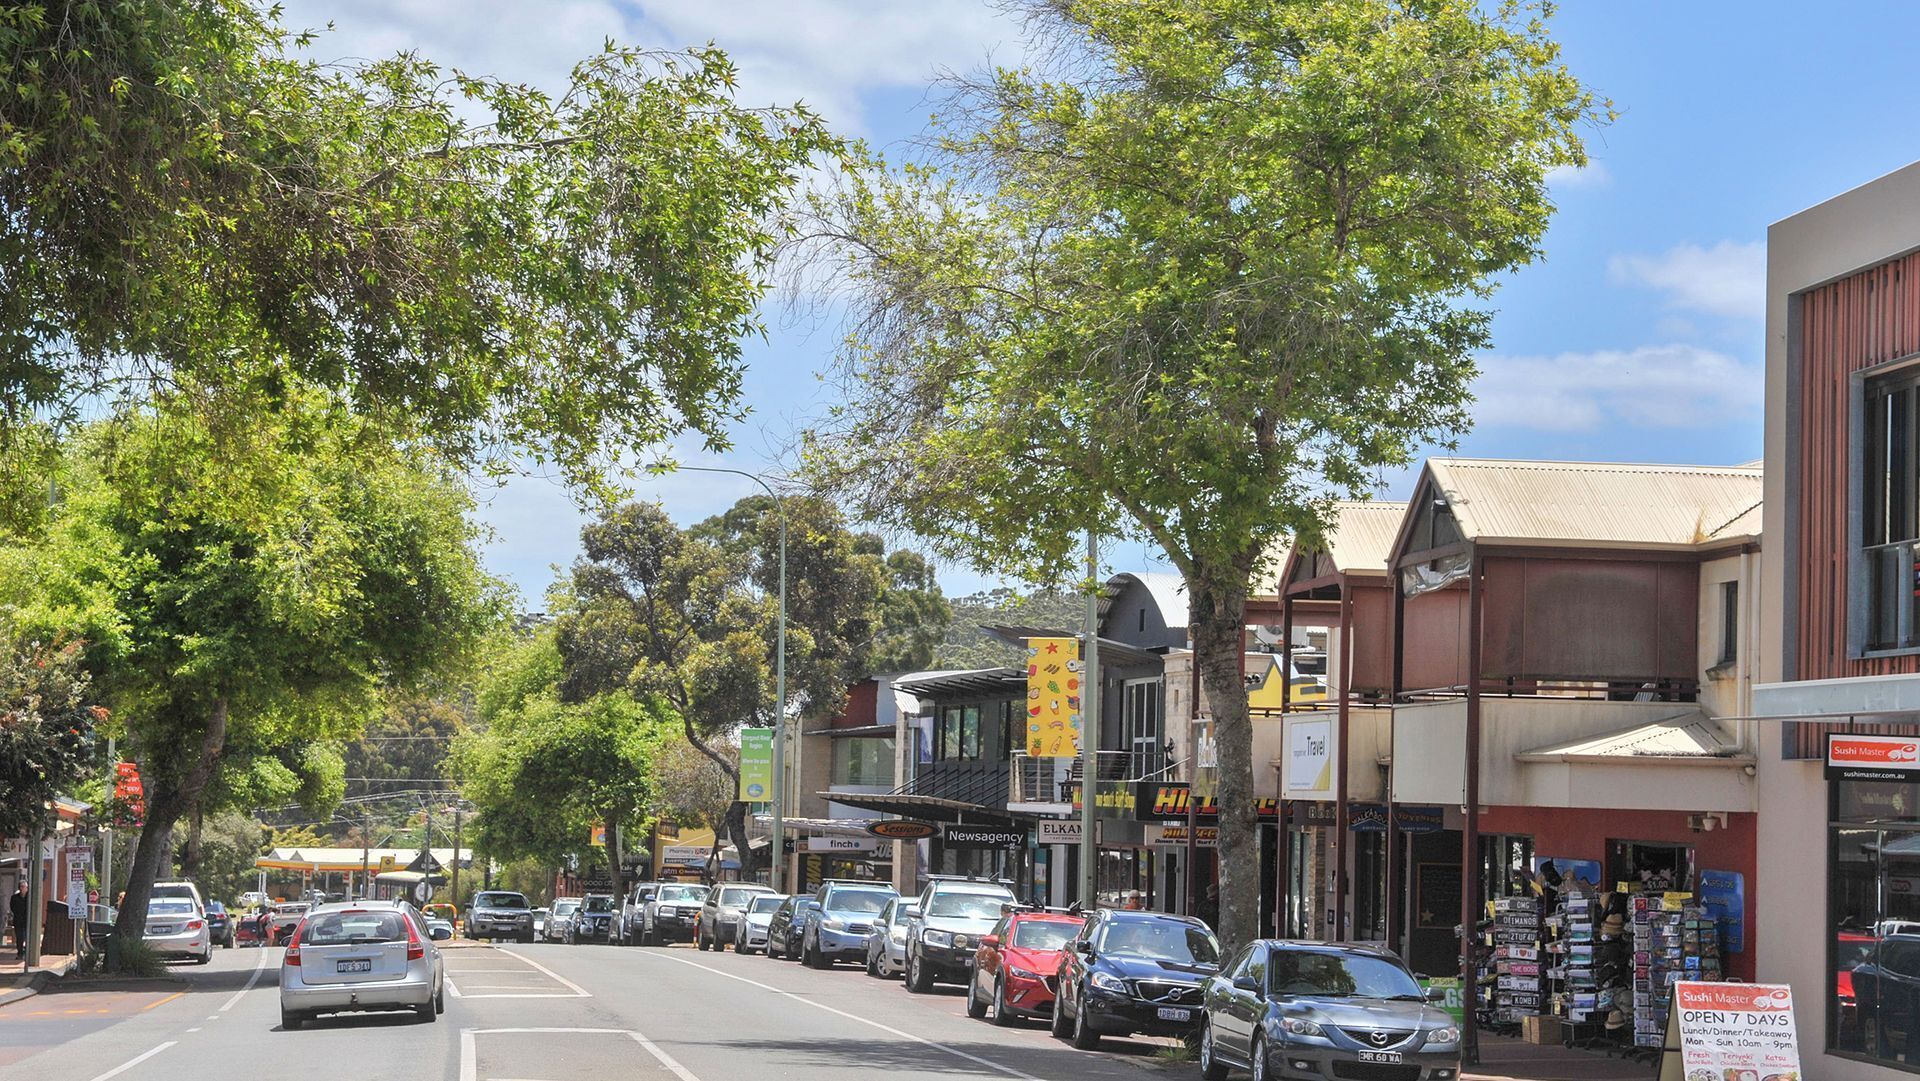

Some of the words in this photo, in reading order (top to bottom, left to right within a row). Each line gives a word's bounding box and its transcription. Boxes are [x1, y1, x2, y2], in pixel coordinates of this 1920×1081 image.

[1306, 735, 1326, 757] Travel
[1834, 746, 1857, 755] Sushi
[1859, 747, 1886, 757] Master
[1844, 771, 1906, 779] sushimaster.com.au
[882, 823, 925, 834] Sessions
[949, 830, 1024, 844] Newsagency
[830, 840, 853, 848] finch
[1683, 991, 1712, 1003] Sushi
[1715, 992, 1750, 1004] Master
[1683, 1011, 1725, 1024] OPEN
[1730, 1012, 1740, 1024] 7
[1747, 1013, 1789, 1026] DAYS
[1682, 1026, 1793, 1039] Lunch/Dinner/Takeaway
[1685, 1037, 1705, 1045] Mon
[1716, 1038, 1734, 1046] Sun
[1737, 1039, 1762, 1047] 10am
[1773, 1040, 1793, 1050] 9pm
